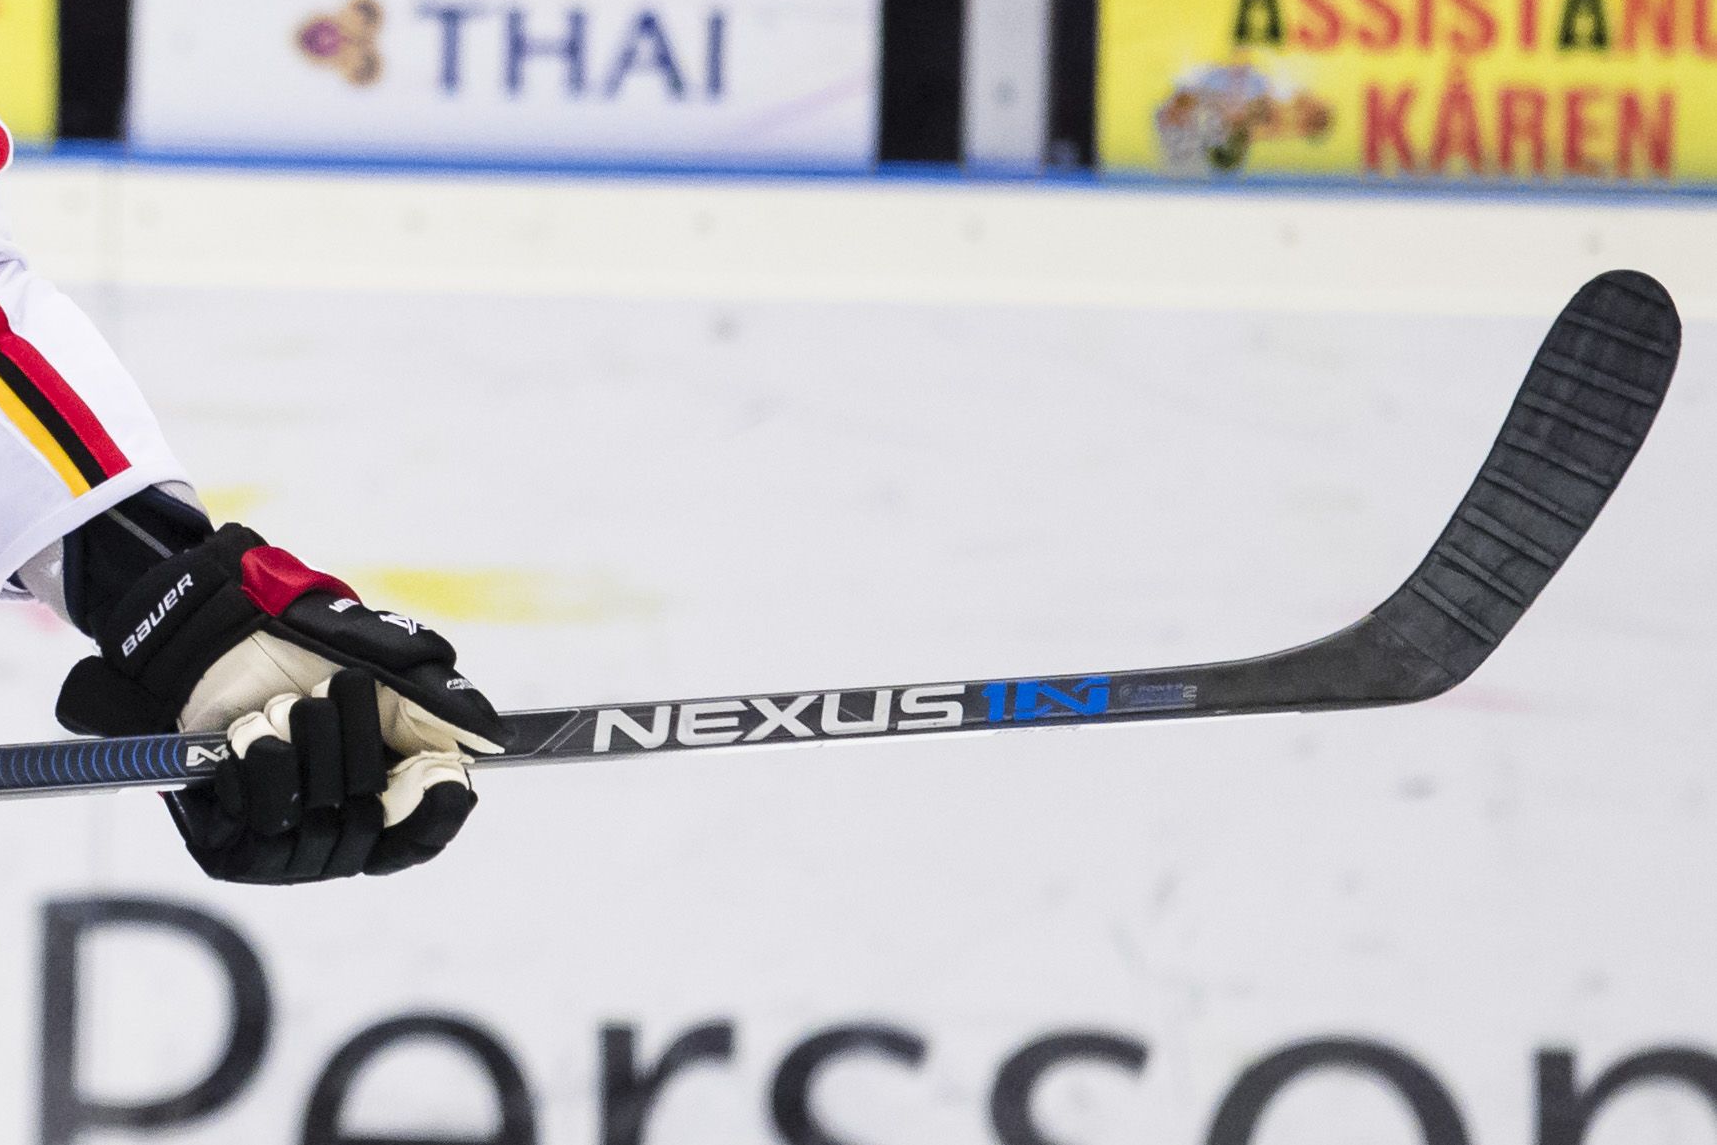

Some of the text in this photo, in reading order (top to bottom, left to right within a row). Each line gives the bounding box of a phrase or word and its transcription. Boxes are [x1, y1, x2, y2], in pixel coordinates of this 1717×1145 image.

[1364, 56, 1676, 174] KÅREN
[121, 572, 194, 658] BAUER
[592, 684, 966, 753] NEXUS
